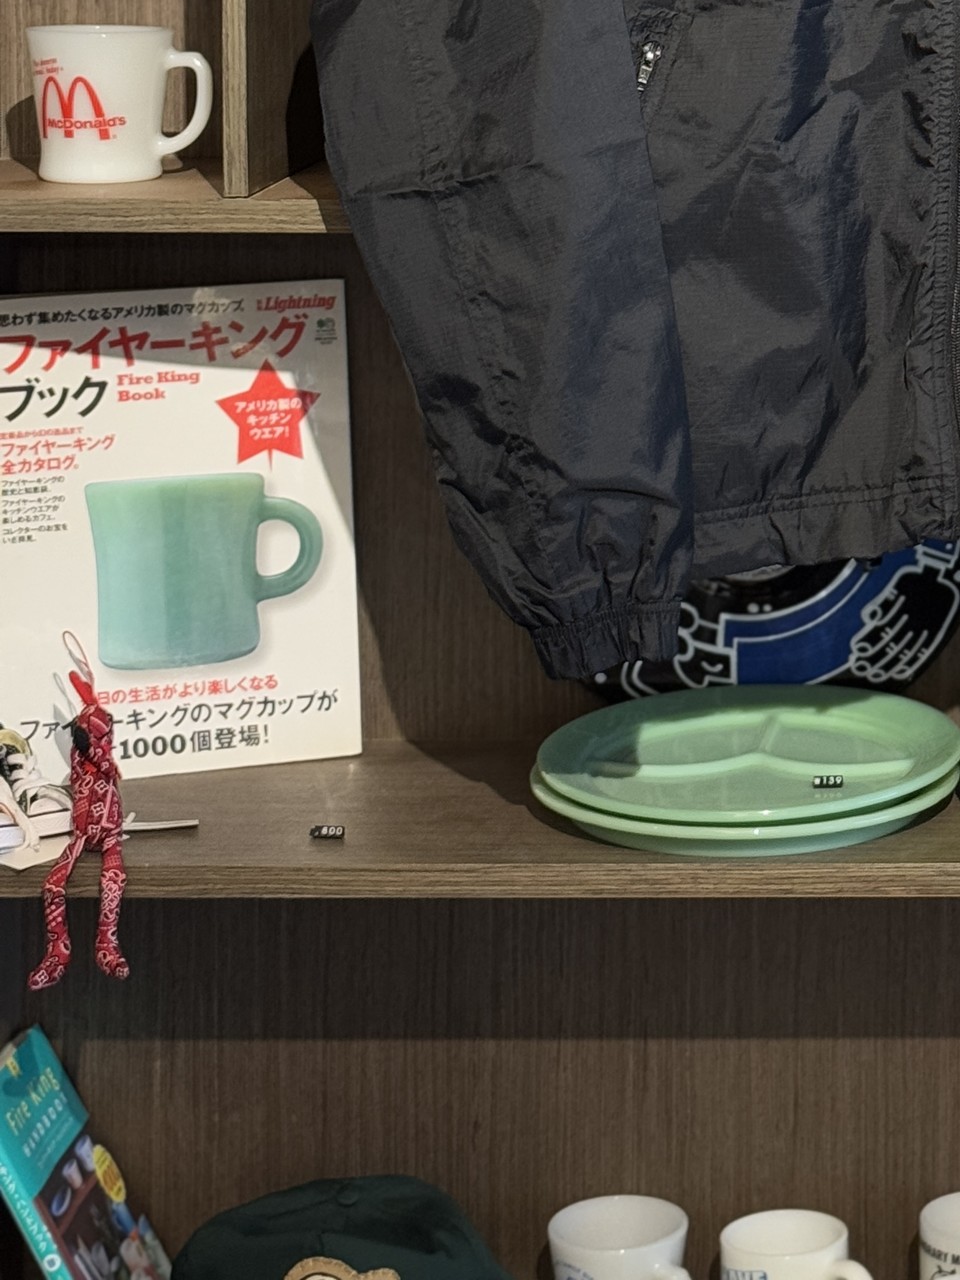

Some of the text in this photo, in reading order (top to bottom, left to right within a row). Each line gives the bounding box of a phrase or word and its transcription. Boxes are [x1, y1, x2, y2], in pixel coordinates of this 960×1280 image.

[47, 116, 127, 130] McDonald's
[264, 293, 337, 313] Lightning
[0, 312, 309, 376] ファイヤーキング
[117, 371, 200, 387] Fire King
[0, 376, 108, 423] ブック
[117, 387, 166, 402] Book
[246, 412, 292, 426] キッチン
[1, 434, 116, 458] ファイヤーキング
[1, 454, 80, 475] 全カタログ。
[97, 674, 280, 706] 日の生活がより楽しくなる
[6, 1100, 31, 1137] Fire
